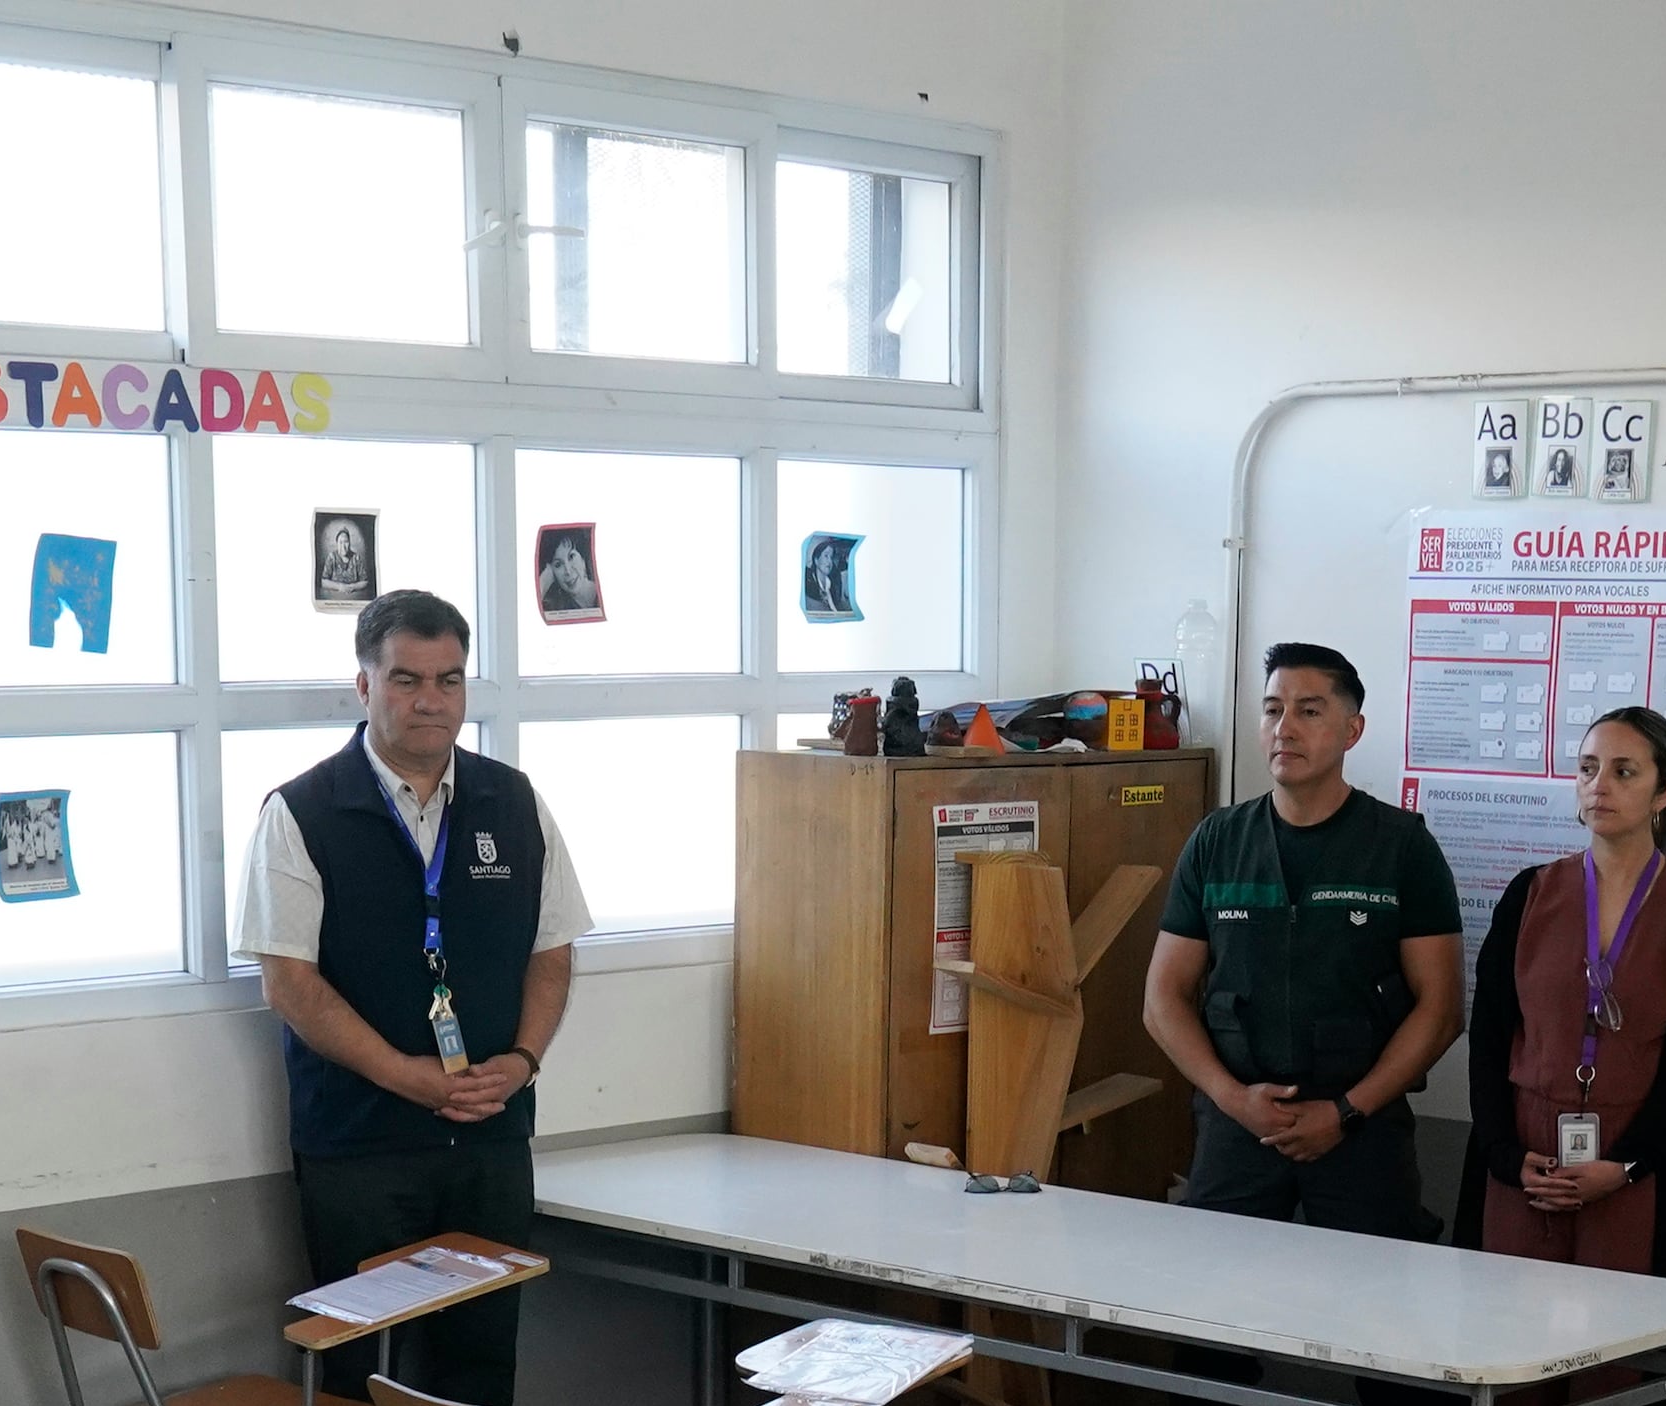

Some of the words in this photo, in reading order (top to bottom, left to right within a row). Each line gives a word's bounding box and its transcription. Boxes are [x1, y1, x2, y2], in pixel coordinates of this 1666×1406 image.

[1477, 405, 1518, 441] Aa
[1541, 402, 1583, 440] Bb
[1602, 406, 1644, 442] Cc
[1447, 528, 1503, 541] ELECCIONES
[1446, 540, 1494, 550] PRESIDENTE
[1497, 541, 1503, 550] Y
[1513, 525, 1584, 558] GUÍA
[1445, 550, 1502, 560] PARLAMENTARIOS
[1512, 561, 1538, 573] PARA
[1540, 561, 1567, 573] MESA
[1570, 561, 1629, 573] RECEPTORA
[1630, 561, 1643, 573] DE
[1471, 584, 1504, 595] AFICHE
[1506, 585, 1573, 596] INFORMATIVO
[1575, 586, 1602, 597] PARA
[1604, 586, 1650, 597] VOCALES
[1448, 602, 1476, 612] VOTOS
[1478, 600, 1515, 613] VÁLIDOS
[1574, 604, 1604, 615] VOTOS
[1606, 605, 1636, 615] NULOS
[1638, 605, 1645, 615] Y
[1646, 606, 1659, 615] EN
[1124, 789, 1164, 803] Estante
[1428, 789, 1474, 802] PROCESOS
[1475, 792, 1492, 803] DEL
[1494, 793, 1548, 806] ESCRUTINIO
[989, 807, 1034, 817] ESCRUTINIO
[962, 826, 983, 835] VOTOS
[984, 824, 1010, 834] VÁLIDOS
[469, 865, 511, 874] SANTIAGO
[1369, 894, 1381, 903] DE
[1217, 910, 1249, 921] MOLINA
